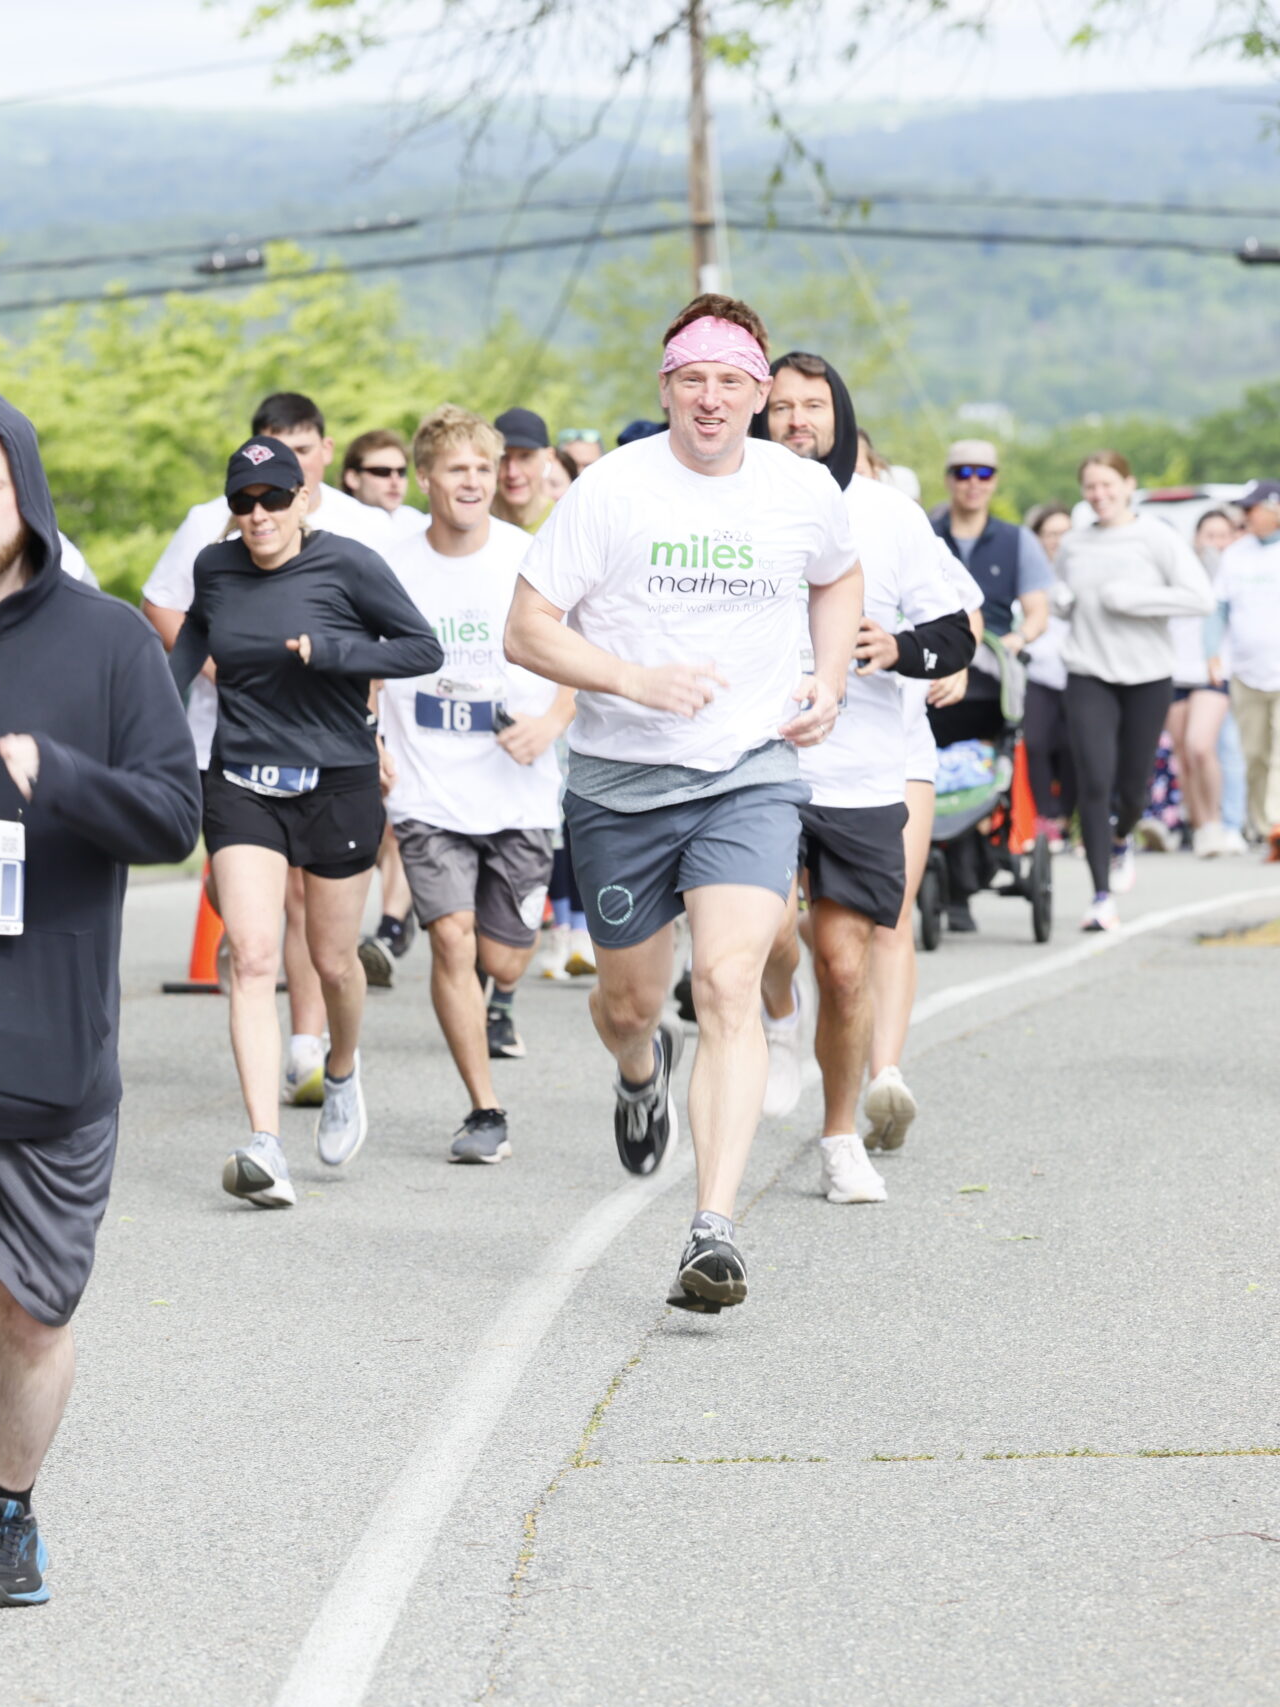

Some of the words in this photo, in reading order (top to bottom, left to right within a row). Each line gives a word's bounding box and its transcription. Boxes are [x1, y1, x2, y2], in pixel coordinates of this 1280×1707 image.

[650, 533, 754, 570] miles
[647, 571, 783, 598] matheny
[431, 616, 490, 644] iles
[438, 699, 472, 732] 16
